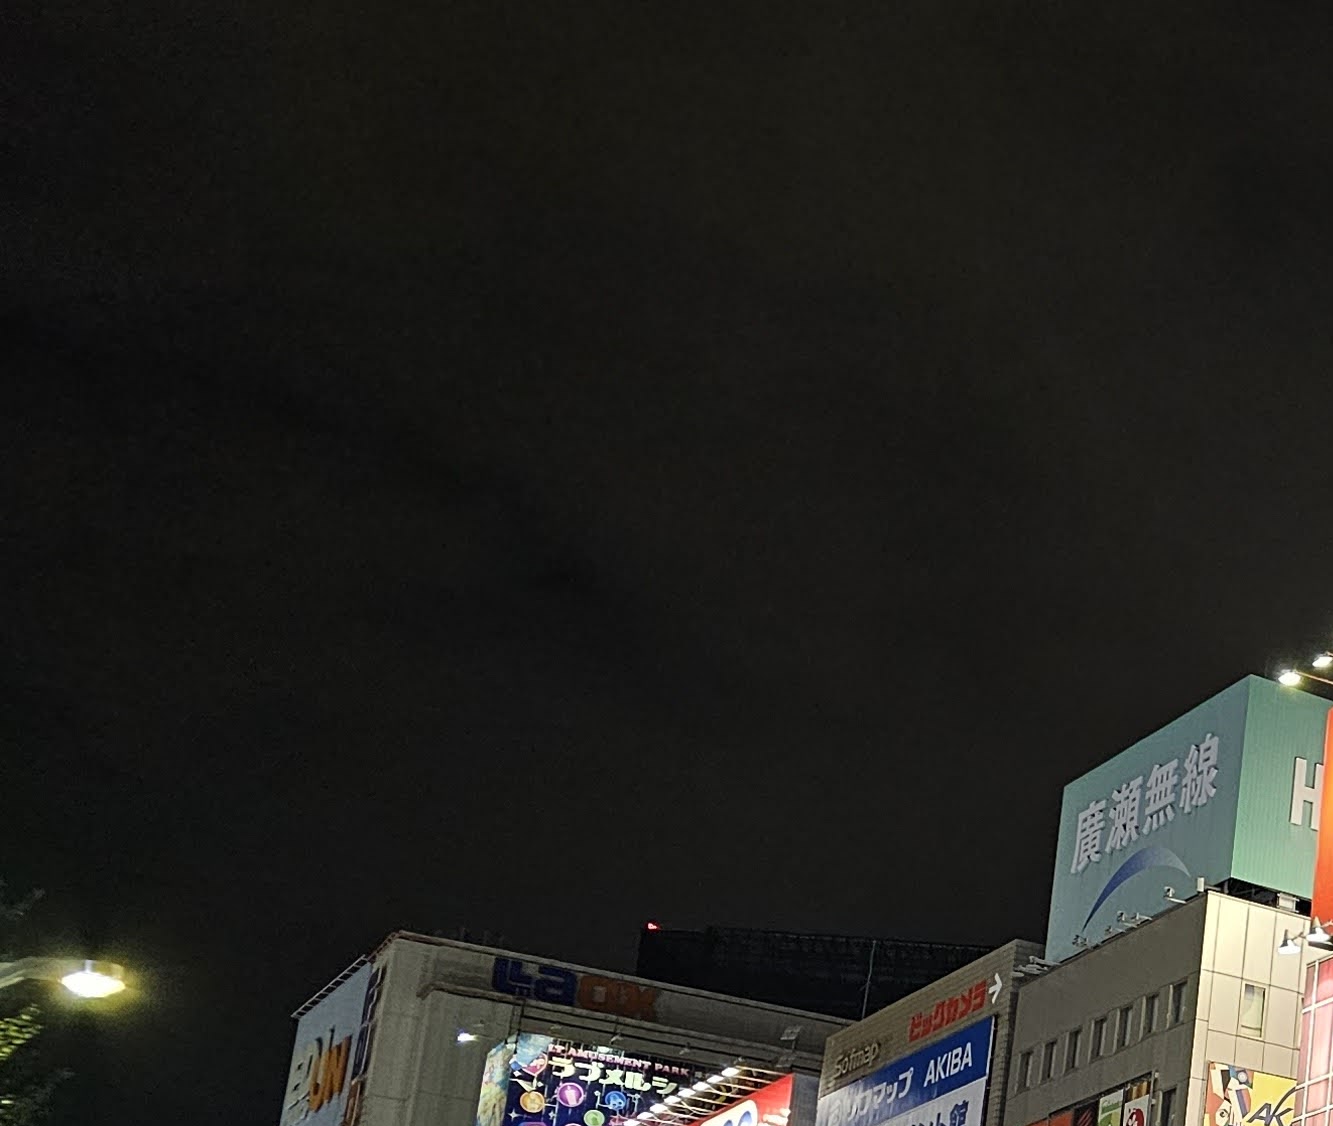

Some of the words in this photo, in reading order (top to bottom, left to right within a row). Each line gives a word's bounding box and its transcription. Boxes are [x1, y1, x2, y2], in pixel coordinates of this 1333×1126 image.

[1070, 732, 1221, 876] 廣瀬無線
[908, 979, 988, 1043] ビックカメラ
[568, 1047, 652, 1070] AMUSEMENT
[655, 1062, 690, 1077] PARK
[832, 1042, 880, 1080] Sofmap
[923, 1042, 973, 1088] AKIBA
